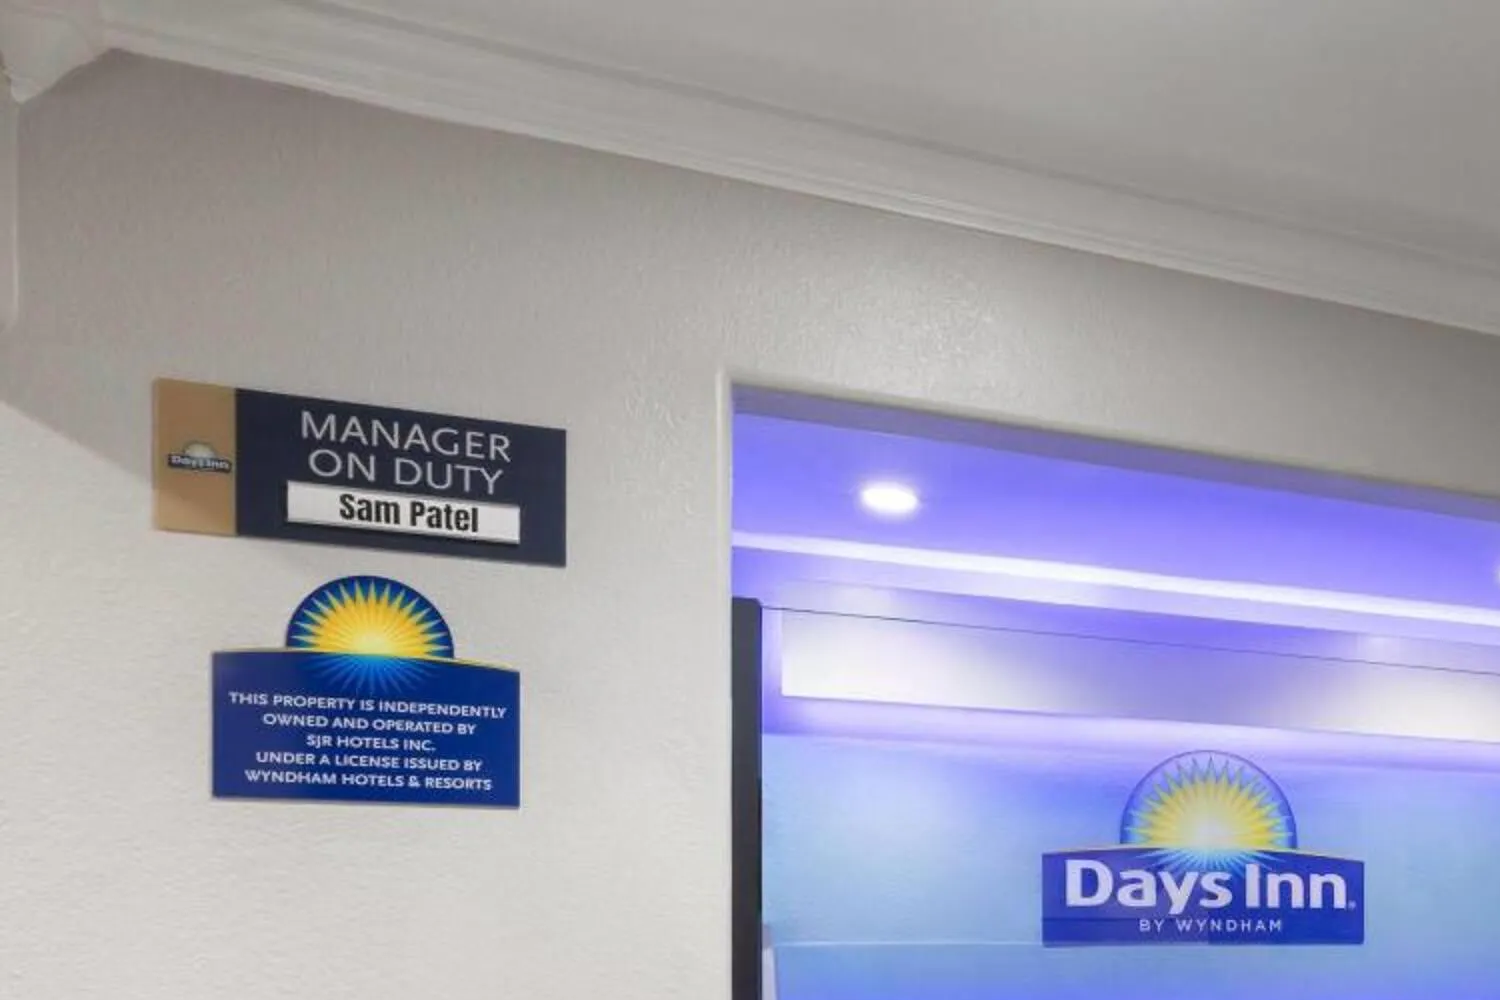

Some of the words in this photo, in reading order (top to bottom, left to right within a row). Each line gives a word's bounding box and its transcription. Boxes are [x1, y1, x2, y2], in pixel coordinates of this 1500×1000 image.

[301, 409, 511, 463] MANAGER
[308, 448, 376, 483] ON
[394, 456, 503, 495] DUTY
[339, 493, 401, 526] Sam
[410, 500, 479, 533] Patel
[228, 691, 269, 706] THIS
[273, 695, 355, 710] PROPERTY
[360, 699, 375, 712] IS
[379, 699, 507, 719] INDEPENDENTLY
[263, 713, 328, 728] OWNED
[331, 717, 369, 730] AND
[372, 719, 454, 734] OPERATED
[457, 723, 477, 735] BY
[306, 734, 332, 749] SJR
[336, 735, 399, 750] HOTELS
[403, 739, 436, 752] INC.
[255, 751, 316, 766] UNDER
[319, 754, 332, 766] A
[335, 755, 400, 769] LICENSE
[404, 758, 461, 771] ISSUED
[463, 760, 483, 772] BY
[244, 769, 337, 785] WYNDHAM
[341, 773, 405, 788] HOTELS
[408, 775, 421, 788] &
[425, 777, 493, 791] RESORTS
[1065, 859, 1233, 915] Days
[1245, 863, 1348, 911] Inn
[1139, 919, 1165, 933] BY
[1176, 918, 1283, 933] WYNDHAM
